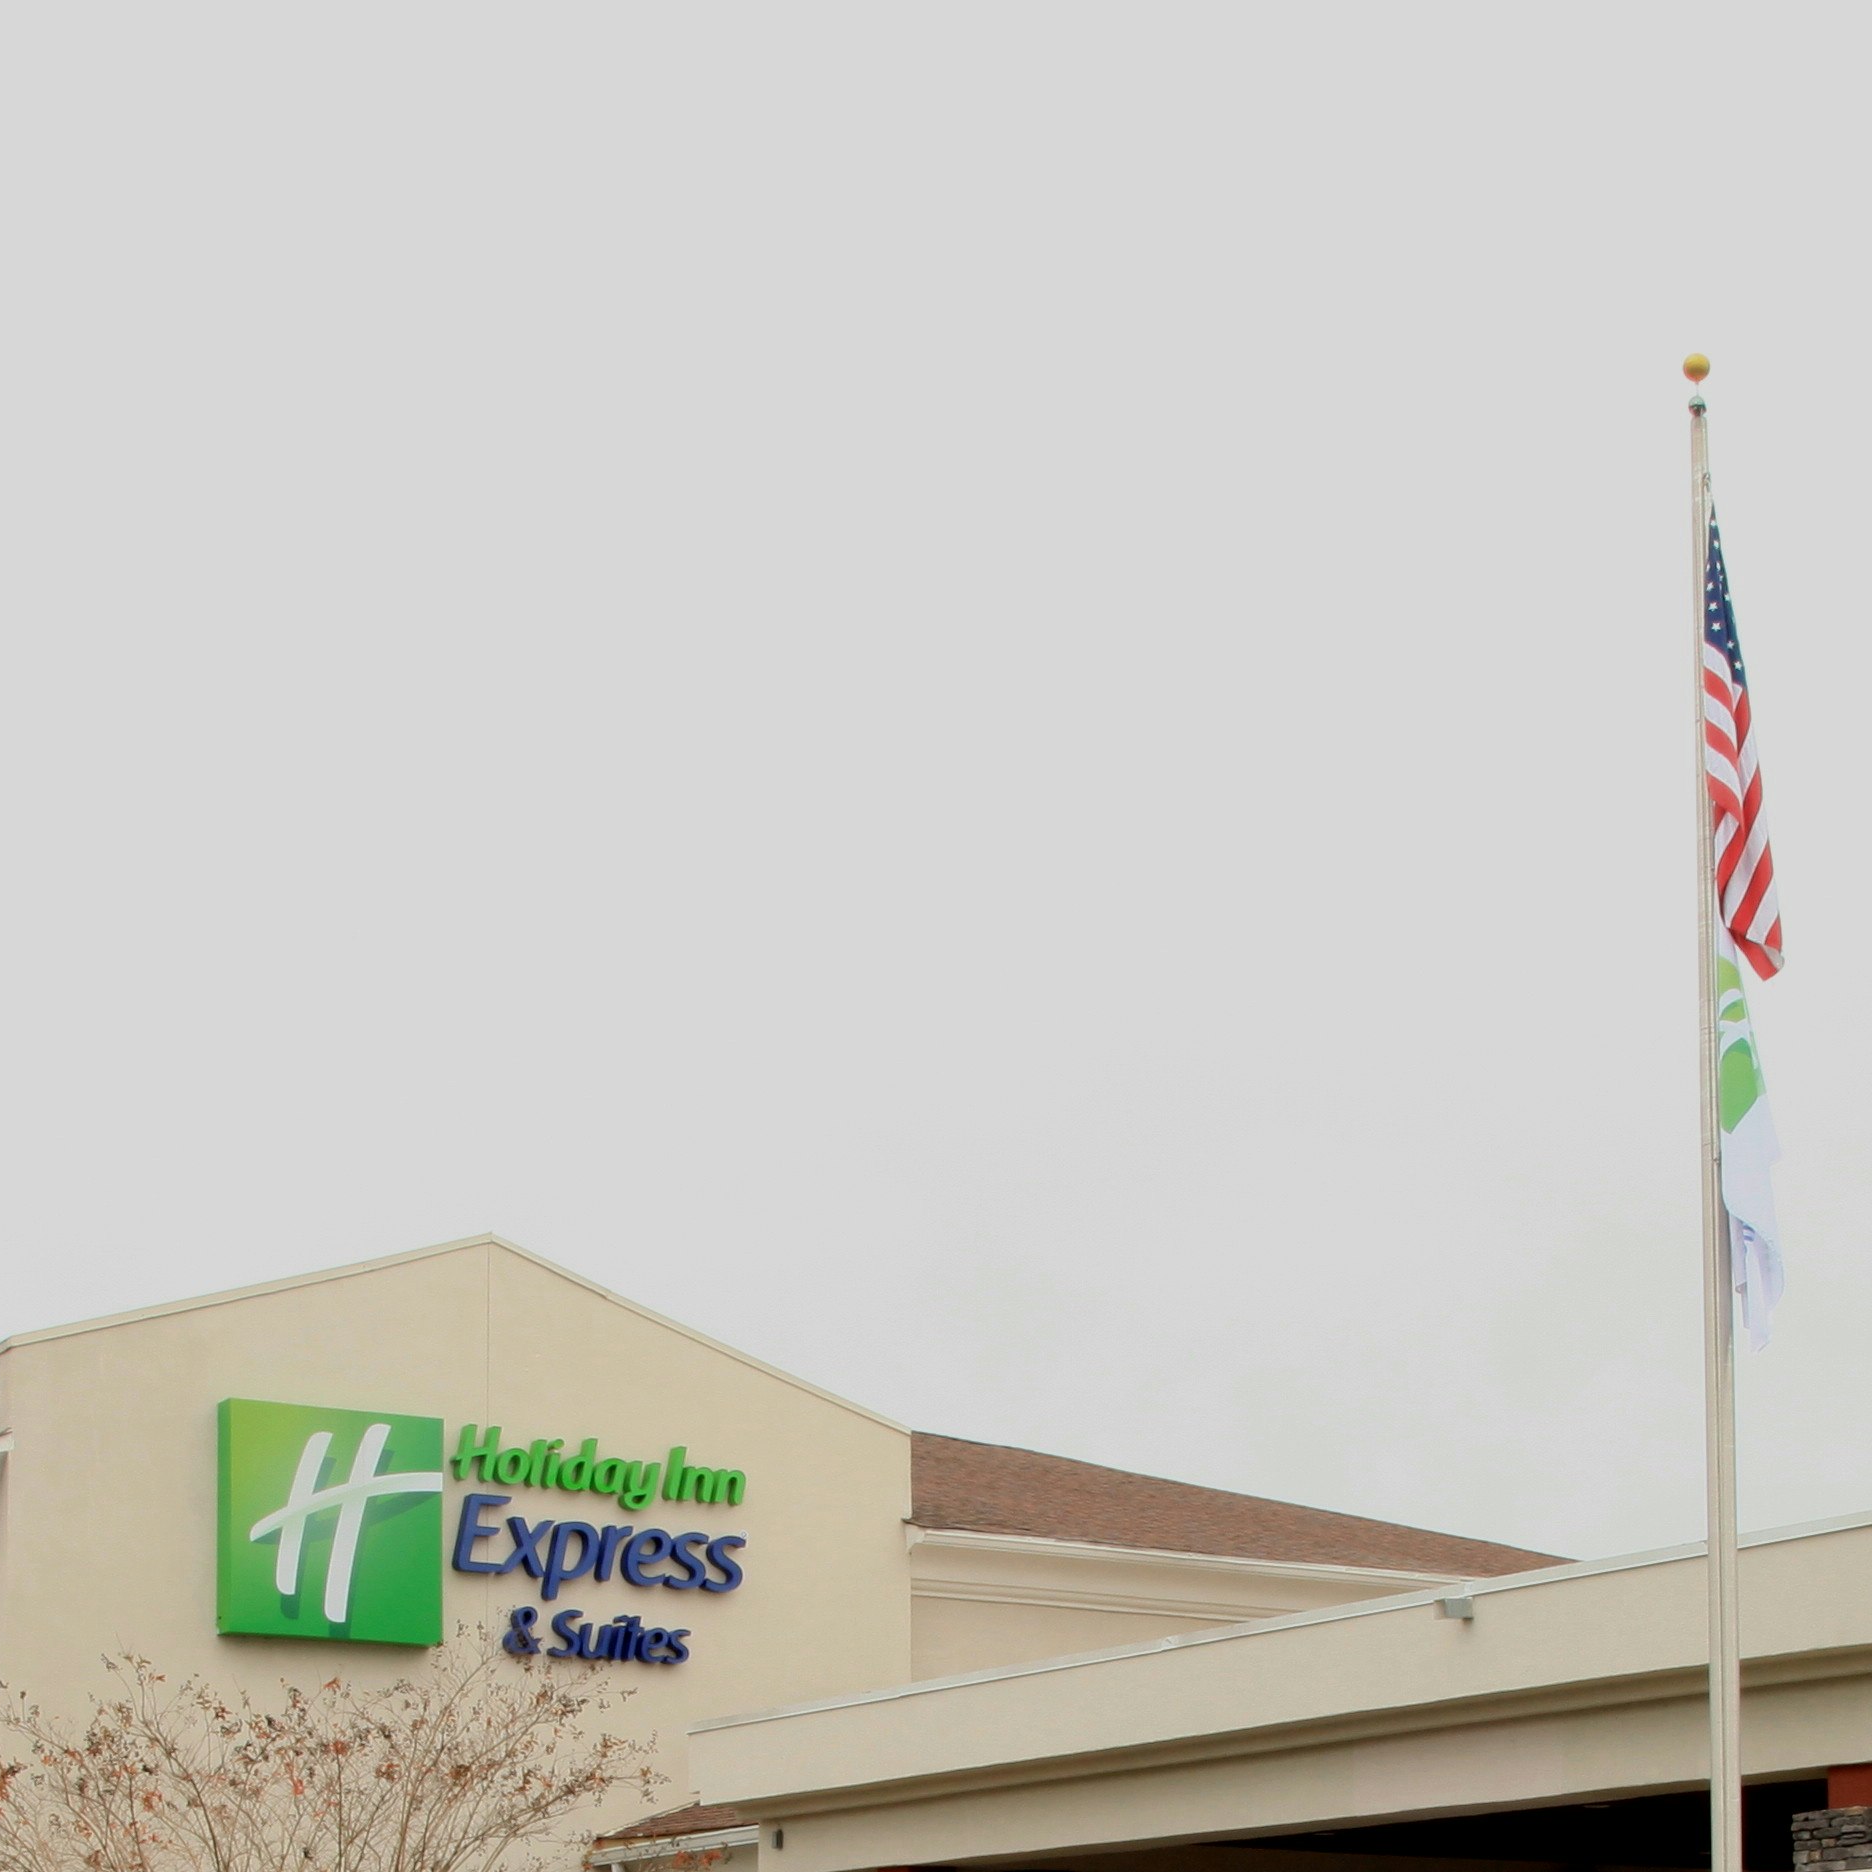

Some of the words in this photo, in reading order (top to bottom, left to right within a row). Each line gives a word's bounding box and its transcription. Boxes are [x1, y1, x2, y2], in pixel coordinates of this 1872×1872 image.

[450, 1423, 661, 1511] Holiday
[661, 1445, 746, 1506] Inn
[452, 1493, 746, 1601] Express
[502, 1606, 542, 1654] &
[546, 1609, 692, 1665] Suites
